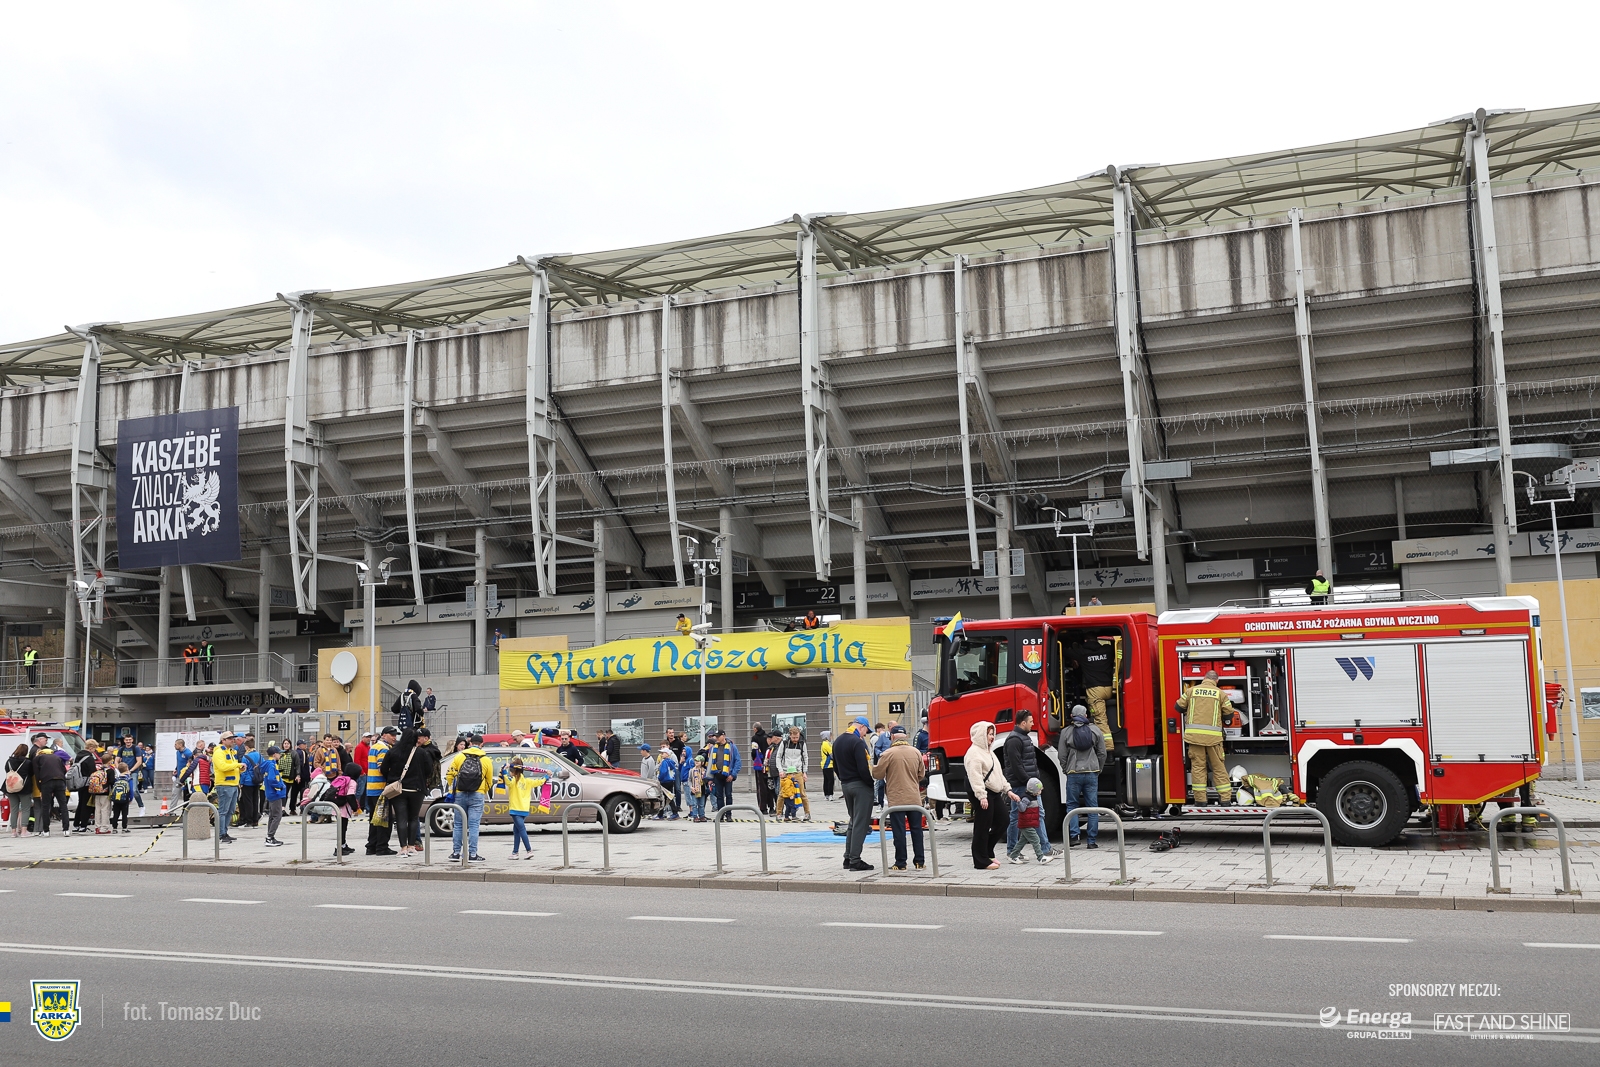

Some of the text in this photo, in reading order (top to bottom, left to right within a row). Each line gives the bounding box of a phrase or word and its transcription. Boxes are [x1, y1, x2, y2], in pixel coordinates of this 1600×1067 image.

[131, 427, 221, 475] KASZËBË
[133, 507, 188, 544] ARKA
[1369, 552, 1388, 566] 21
[1405, 548, 1458, 559] GDYNIAsport.pl
[739, 593, 746, 605] J
[821, 587, 836, 600] 22
[303, 620, 309, 631] J
[1244, 614, 1440, 632] OCHOTNICZA STRAŻ POŻARNA GDYNIA WICZLINO
[526, 651, 637, 684] Wiara
[785, 632, 868, 668] Siłą
[229, 694, 250, 706] SKLEP
[264, 692, 283, 704] ARKA
[892, 704, 902, 712] 11
[268, 724, 276, 732] 13
